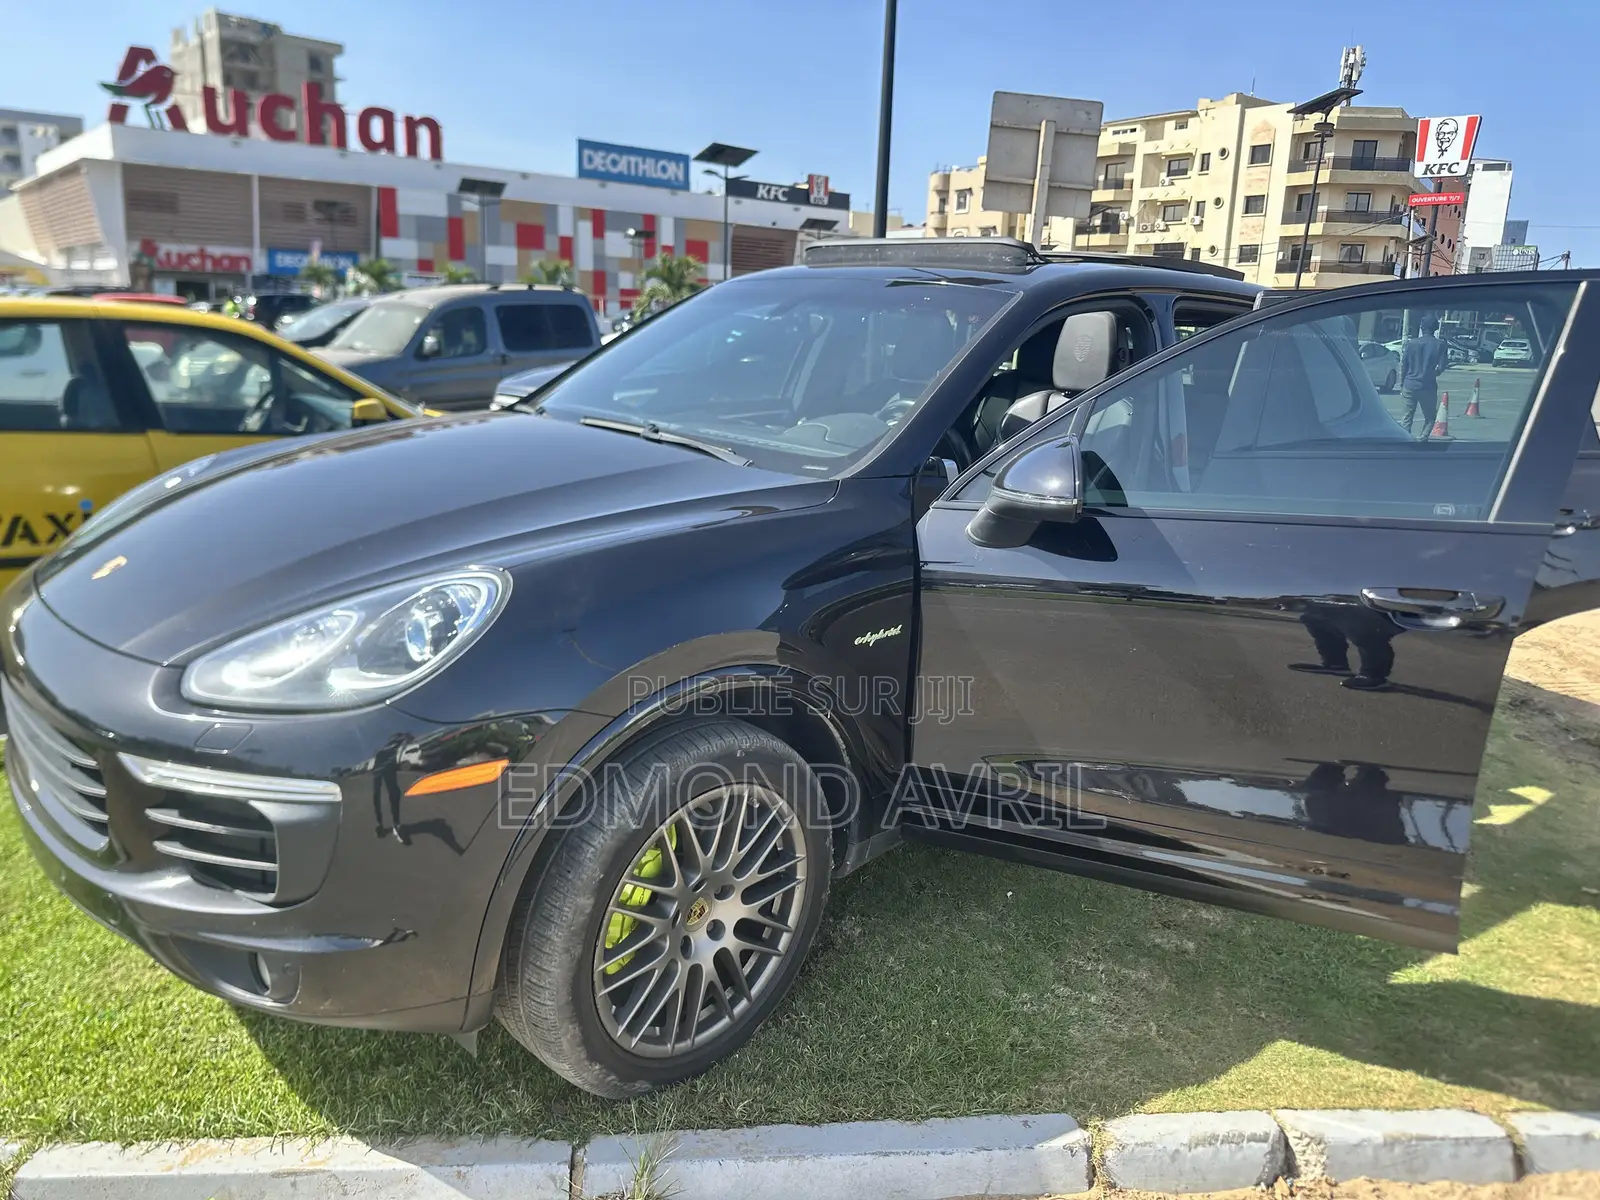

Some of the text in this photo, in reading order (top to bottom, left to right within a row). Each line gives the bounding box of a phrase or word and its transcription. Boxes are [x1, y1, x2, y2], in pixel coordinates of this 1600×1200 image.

[101, 46, 443, 162] Auchan
[582, 149, 684, 183] DECATHLON
[1422, 162, 1460, 176] KFC
[756, 183, 790, 202] KFC
